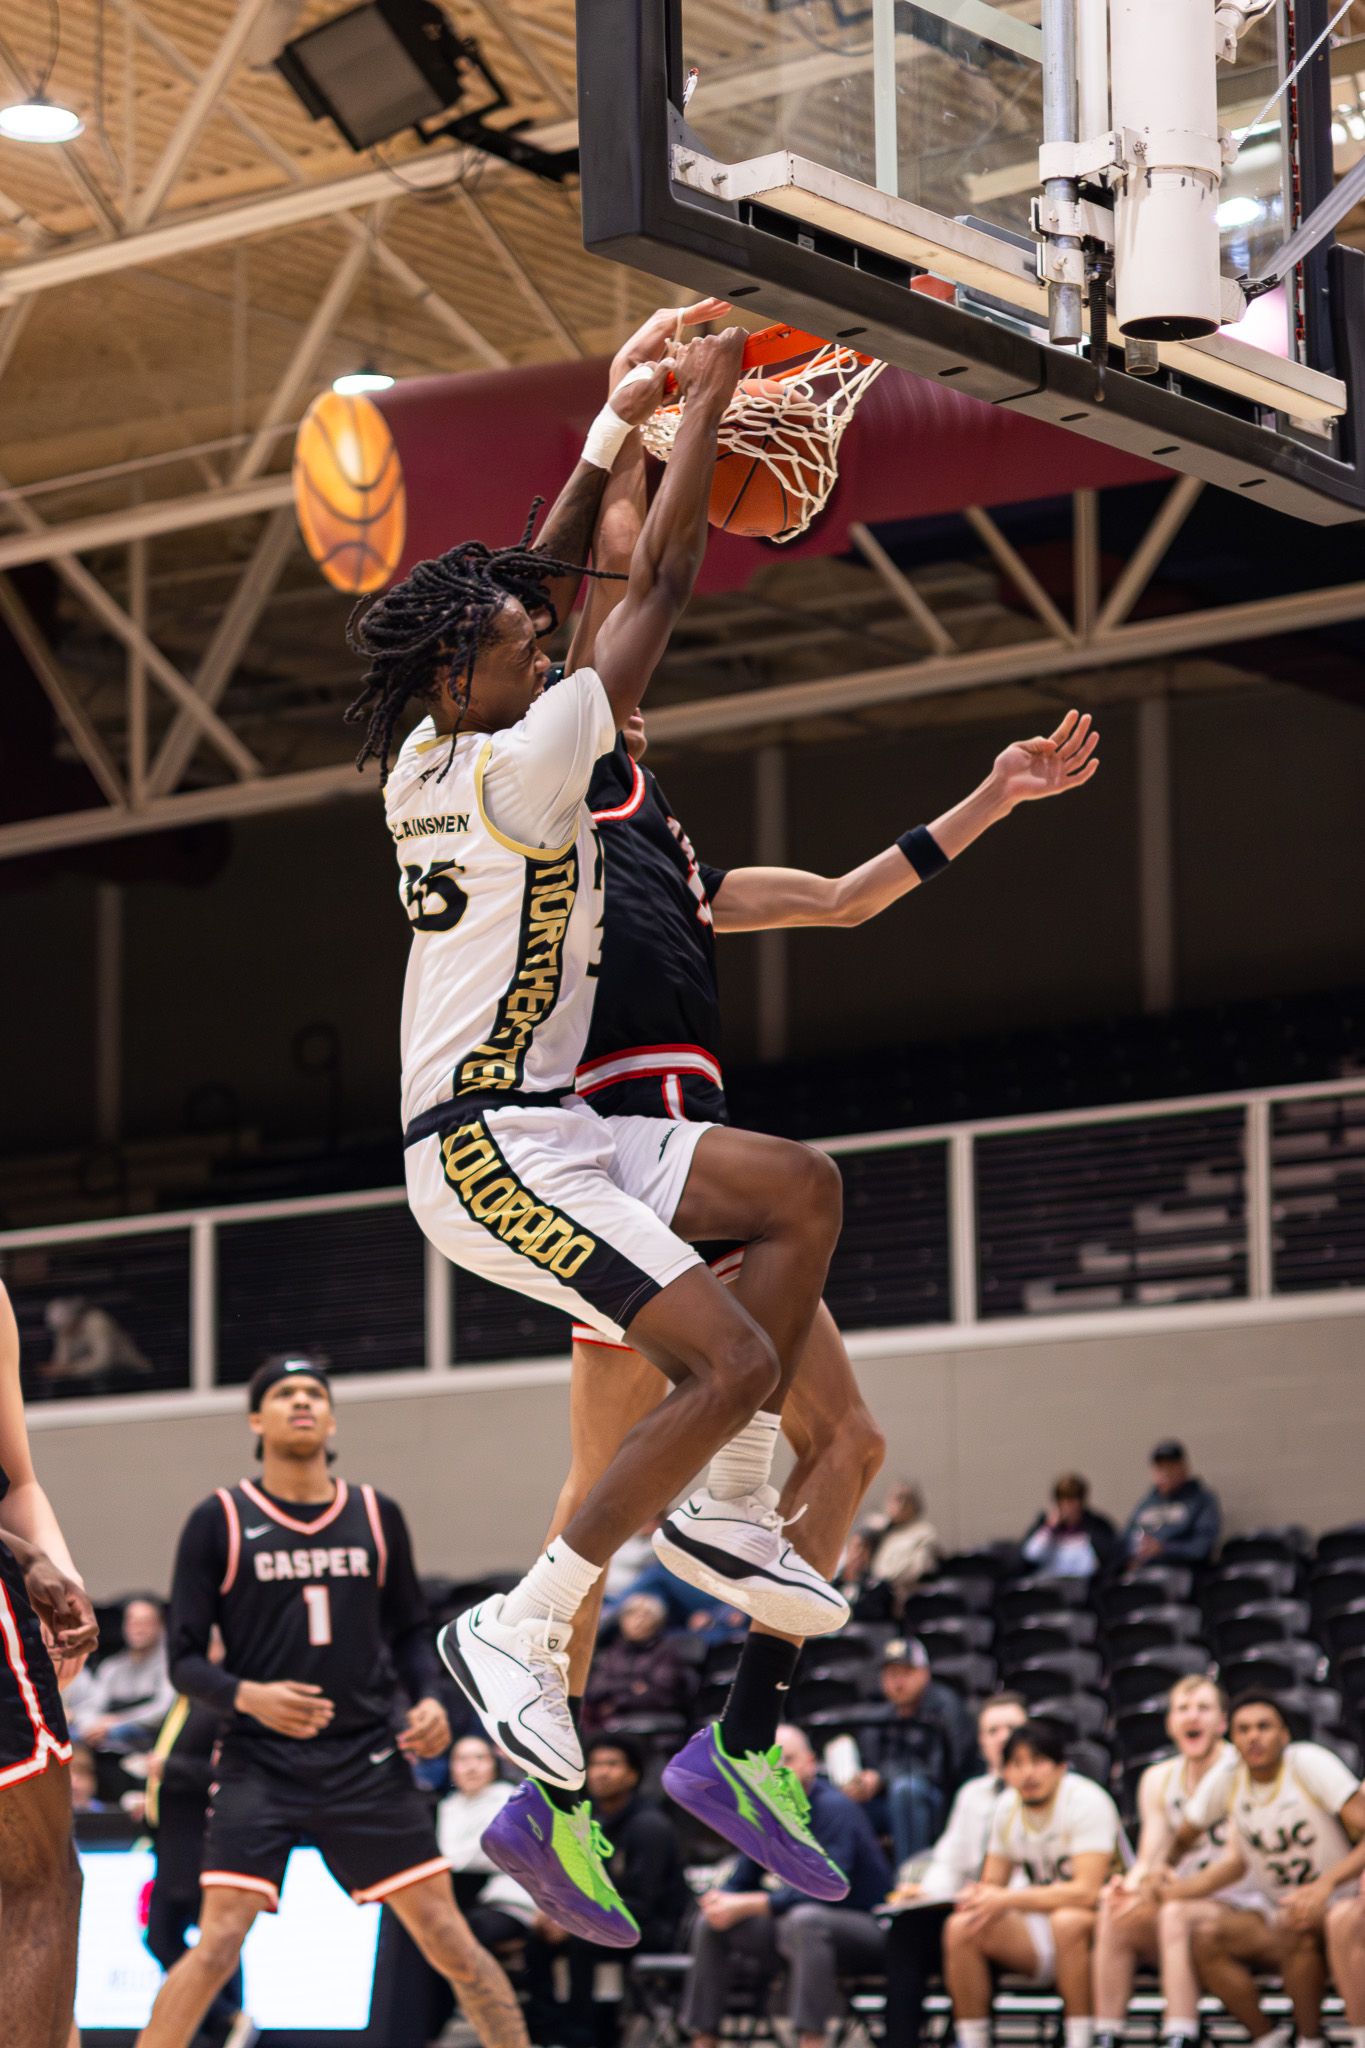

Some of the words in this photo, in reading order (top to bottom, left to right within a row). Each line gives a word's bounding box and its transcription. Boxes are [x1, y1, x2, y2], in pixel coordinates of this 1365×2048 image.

[442, 1120, 597, 1279] COLORADO
[254, 1546, 370, 1582] CASPER
[303, 1585, 332, 1646] 1
